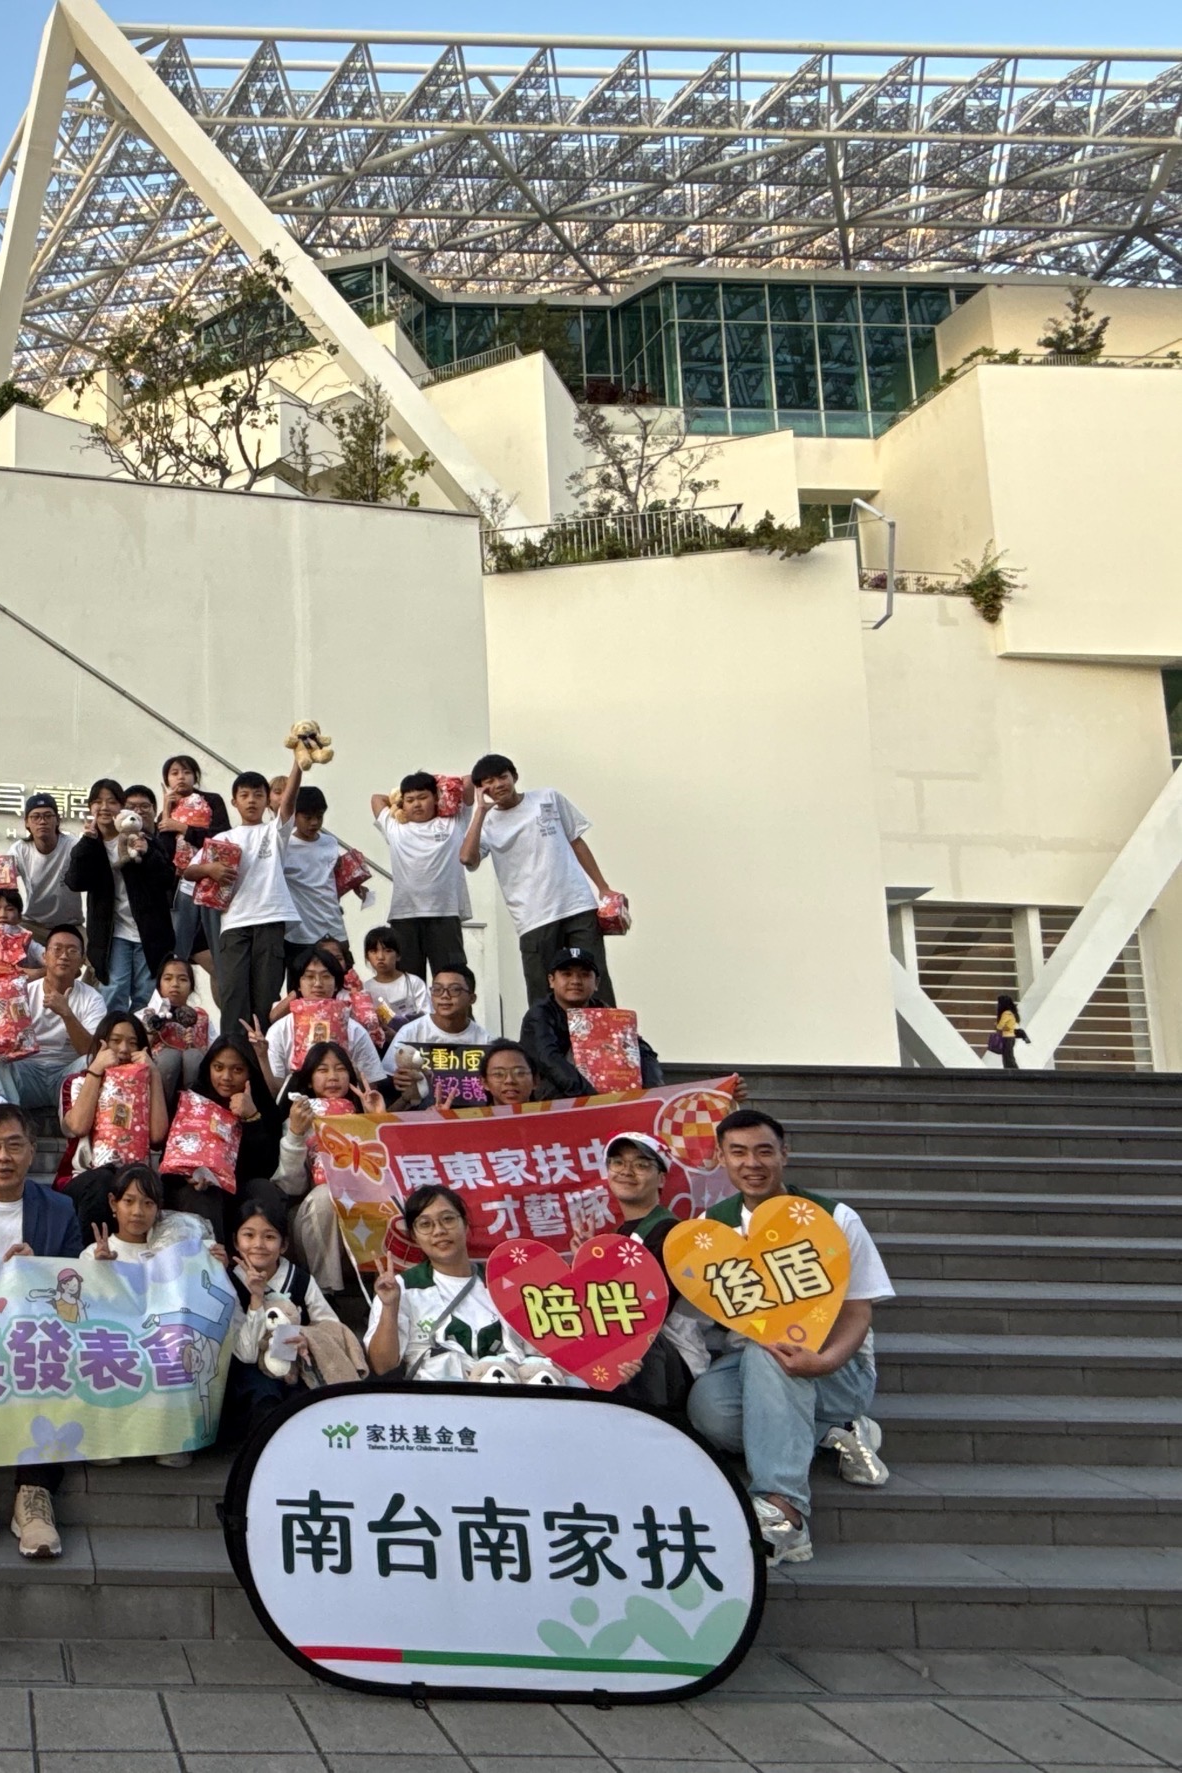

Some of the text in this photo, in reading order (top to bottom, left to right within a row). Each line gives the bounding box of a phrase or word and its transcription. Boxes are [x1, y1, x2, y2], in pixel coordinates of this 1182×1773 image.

[481, 1185, 617, 1239] 才藝隊
[704, 1240, 833, 1318] 後盾
[521, 1281, 645, 1339] 陪伴
[366, 1424, 477, 1446] 家扶基金會
[367, 1443, 389, 1451] Taiwan
[275, 1489, 724, 1592] 南台南家扶
